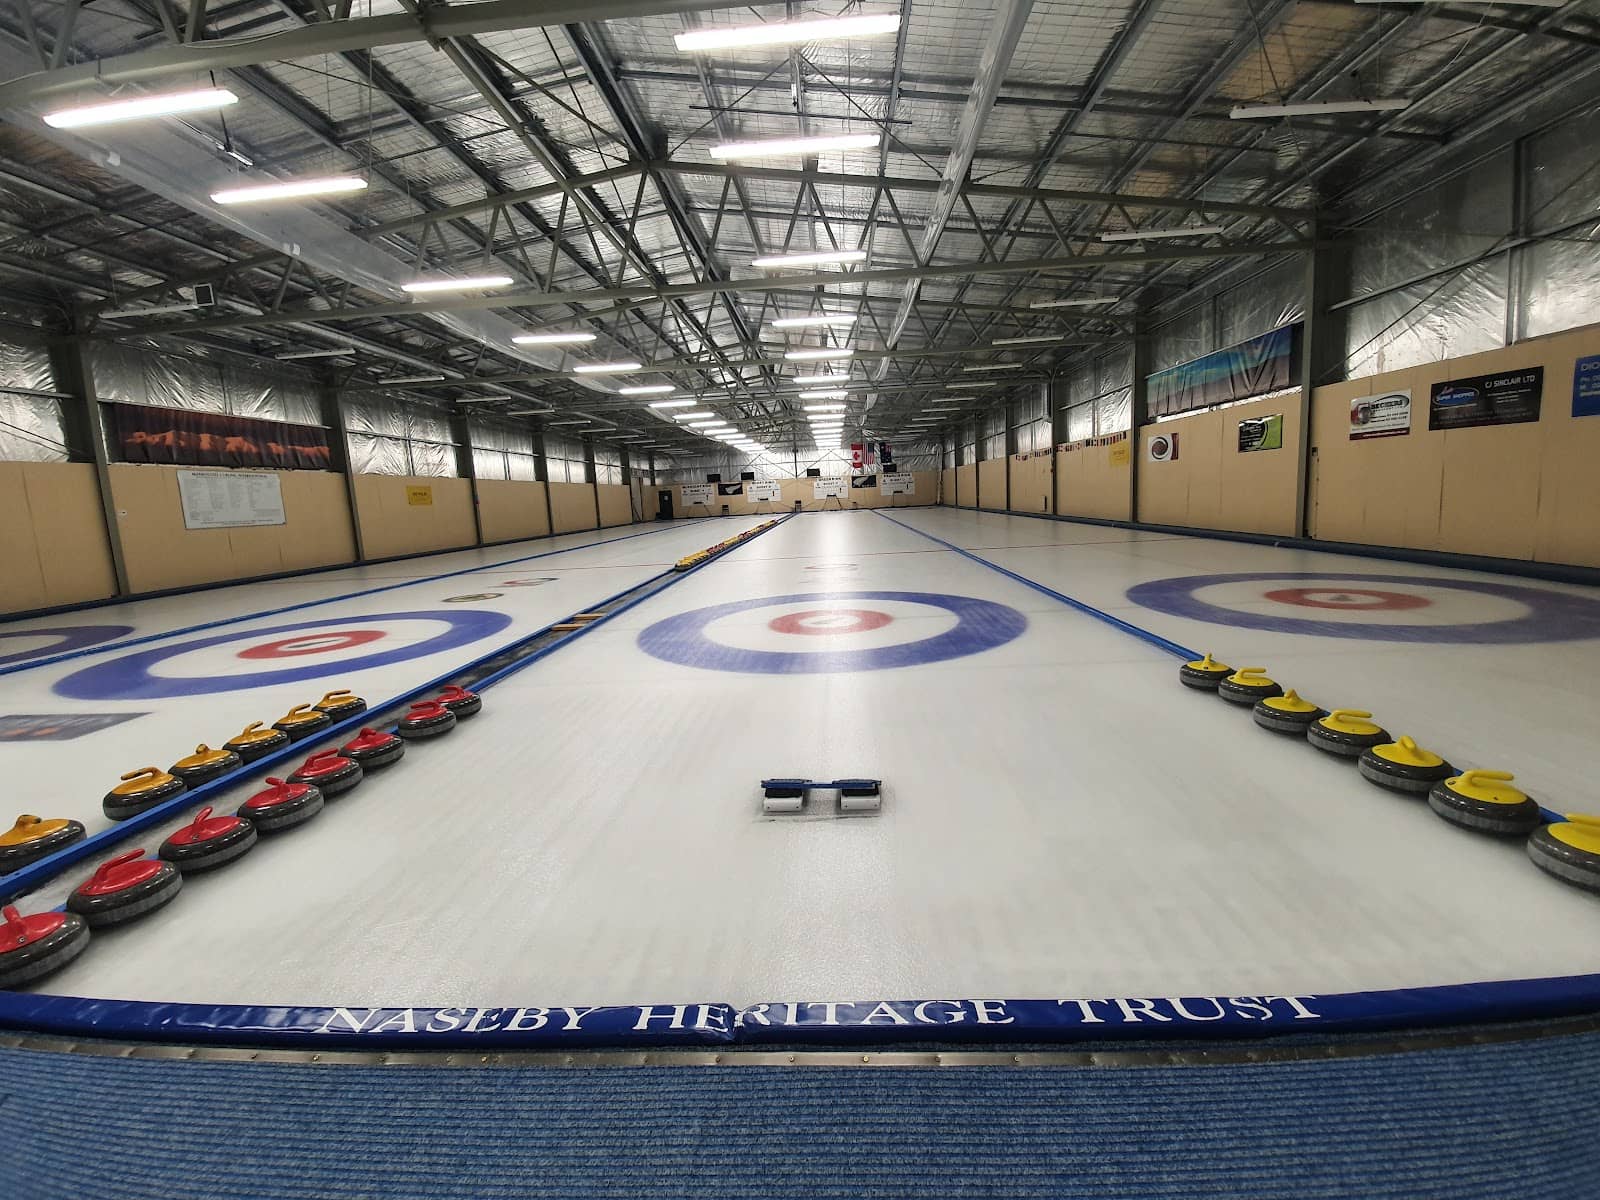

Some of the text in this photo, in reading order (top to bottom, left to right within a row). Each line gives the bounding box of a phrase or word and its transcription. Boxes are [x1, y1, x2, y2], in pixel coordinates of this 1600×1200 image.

[1493, 376, 1521, 388] SINCLAIR
[1522, 374, 1536, 383] LTD
[314, 995, 1322, 1034] NASEBY HERITAGE TRUST
